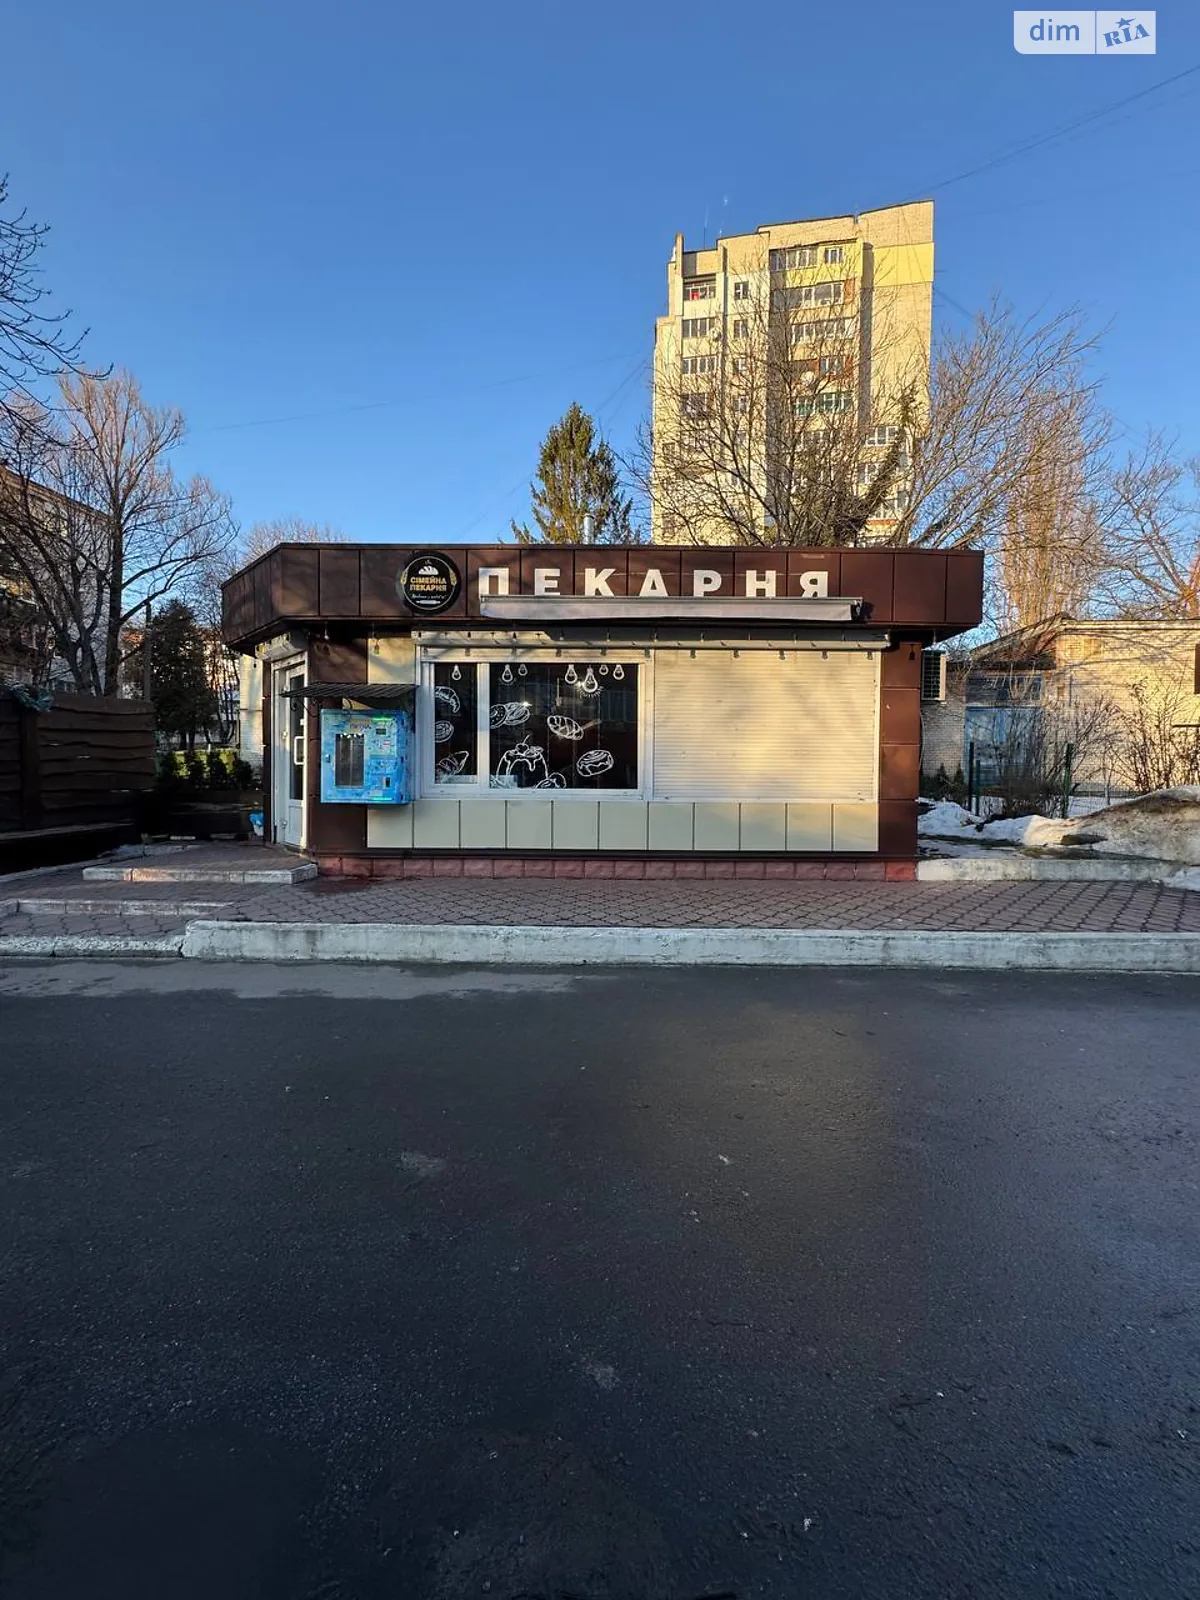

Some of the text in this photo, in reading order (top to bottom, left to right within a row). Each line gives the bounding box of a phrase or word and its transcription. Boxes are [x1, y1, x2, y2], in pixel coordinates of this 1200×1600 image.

[410, 576, 447, 584] СІМЕЙНА
[478, 567, 829, 598] ПЕКАРНЯ
[410, 584, 447, 592] ПЕКАРНЯ
